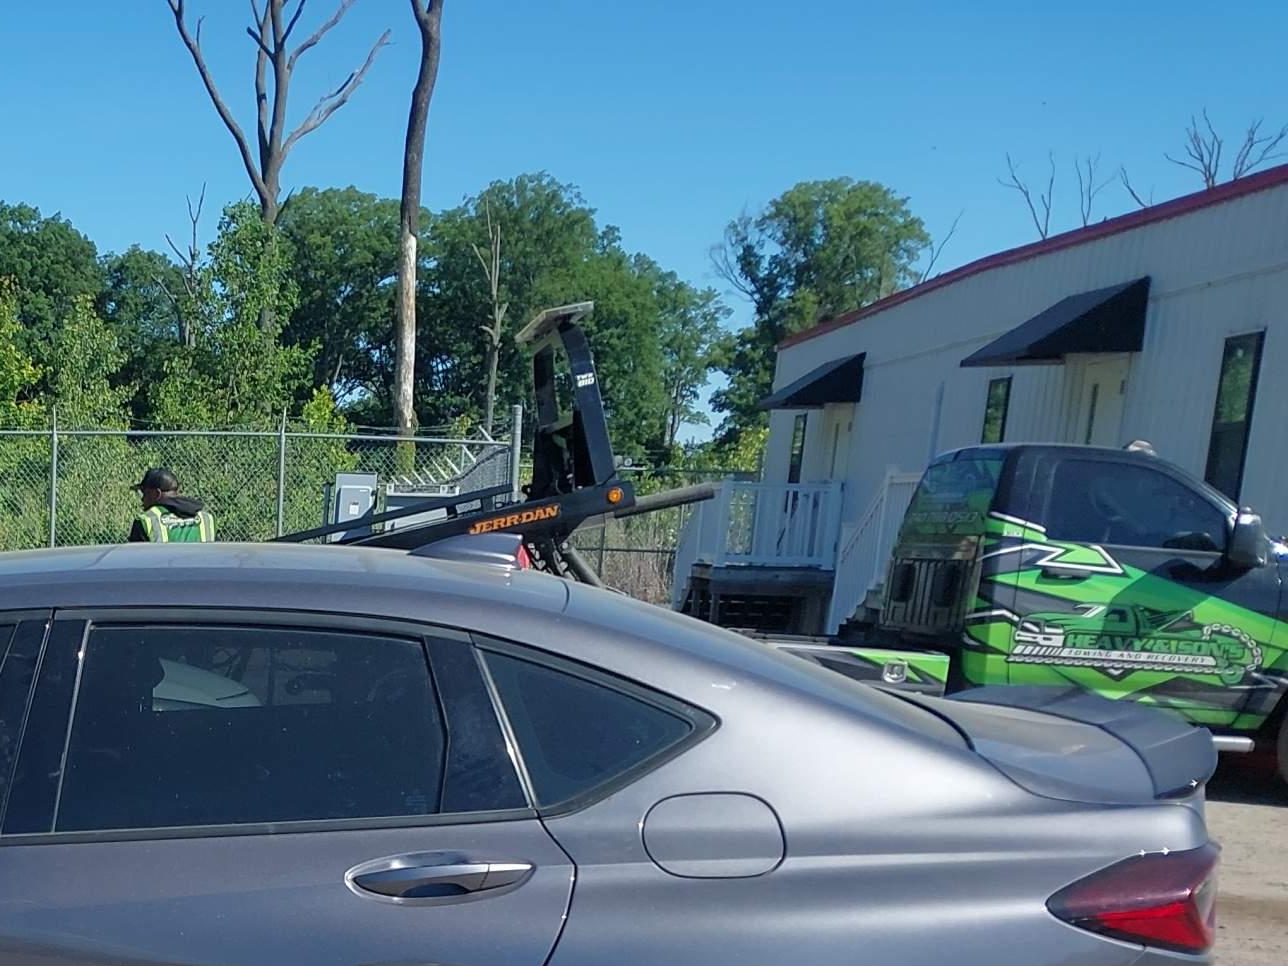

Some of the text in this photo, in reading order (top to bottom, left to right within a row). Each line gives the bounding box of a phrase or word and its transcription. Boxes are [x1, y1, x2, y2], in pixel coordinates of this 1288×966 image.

[1066, 649, 1205, 664] TOWING AND RECOVERY
